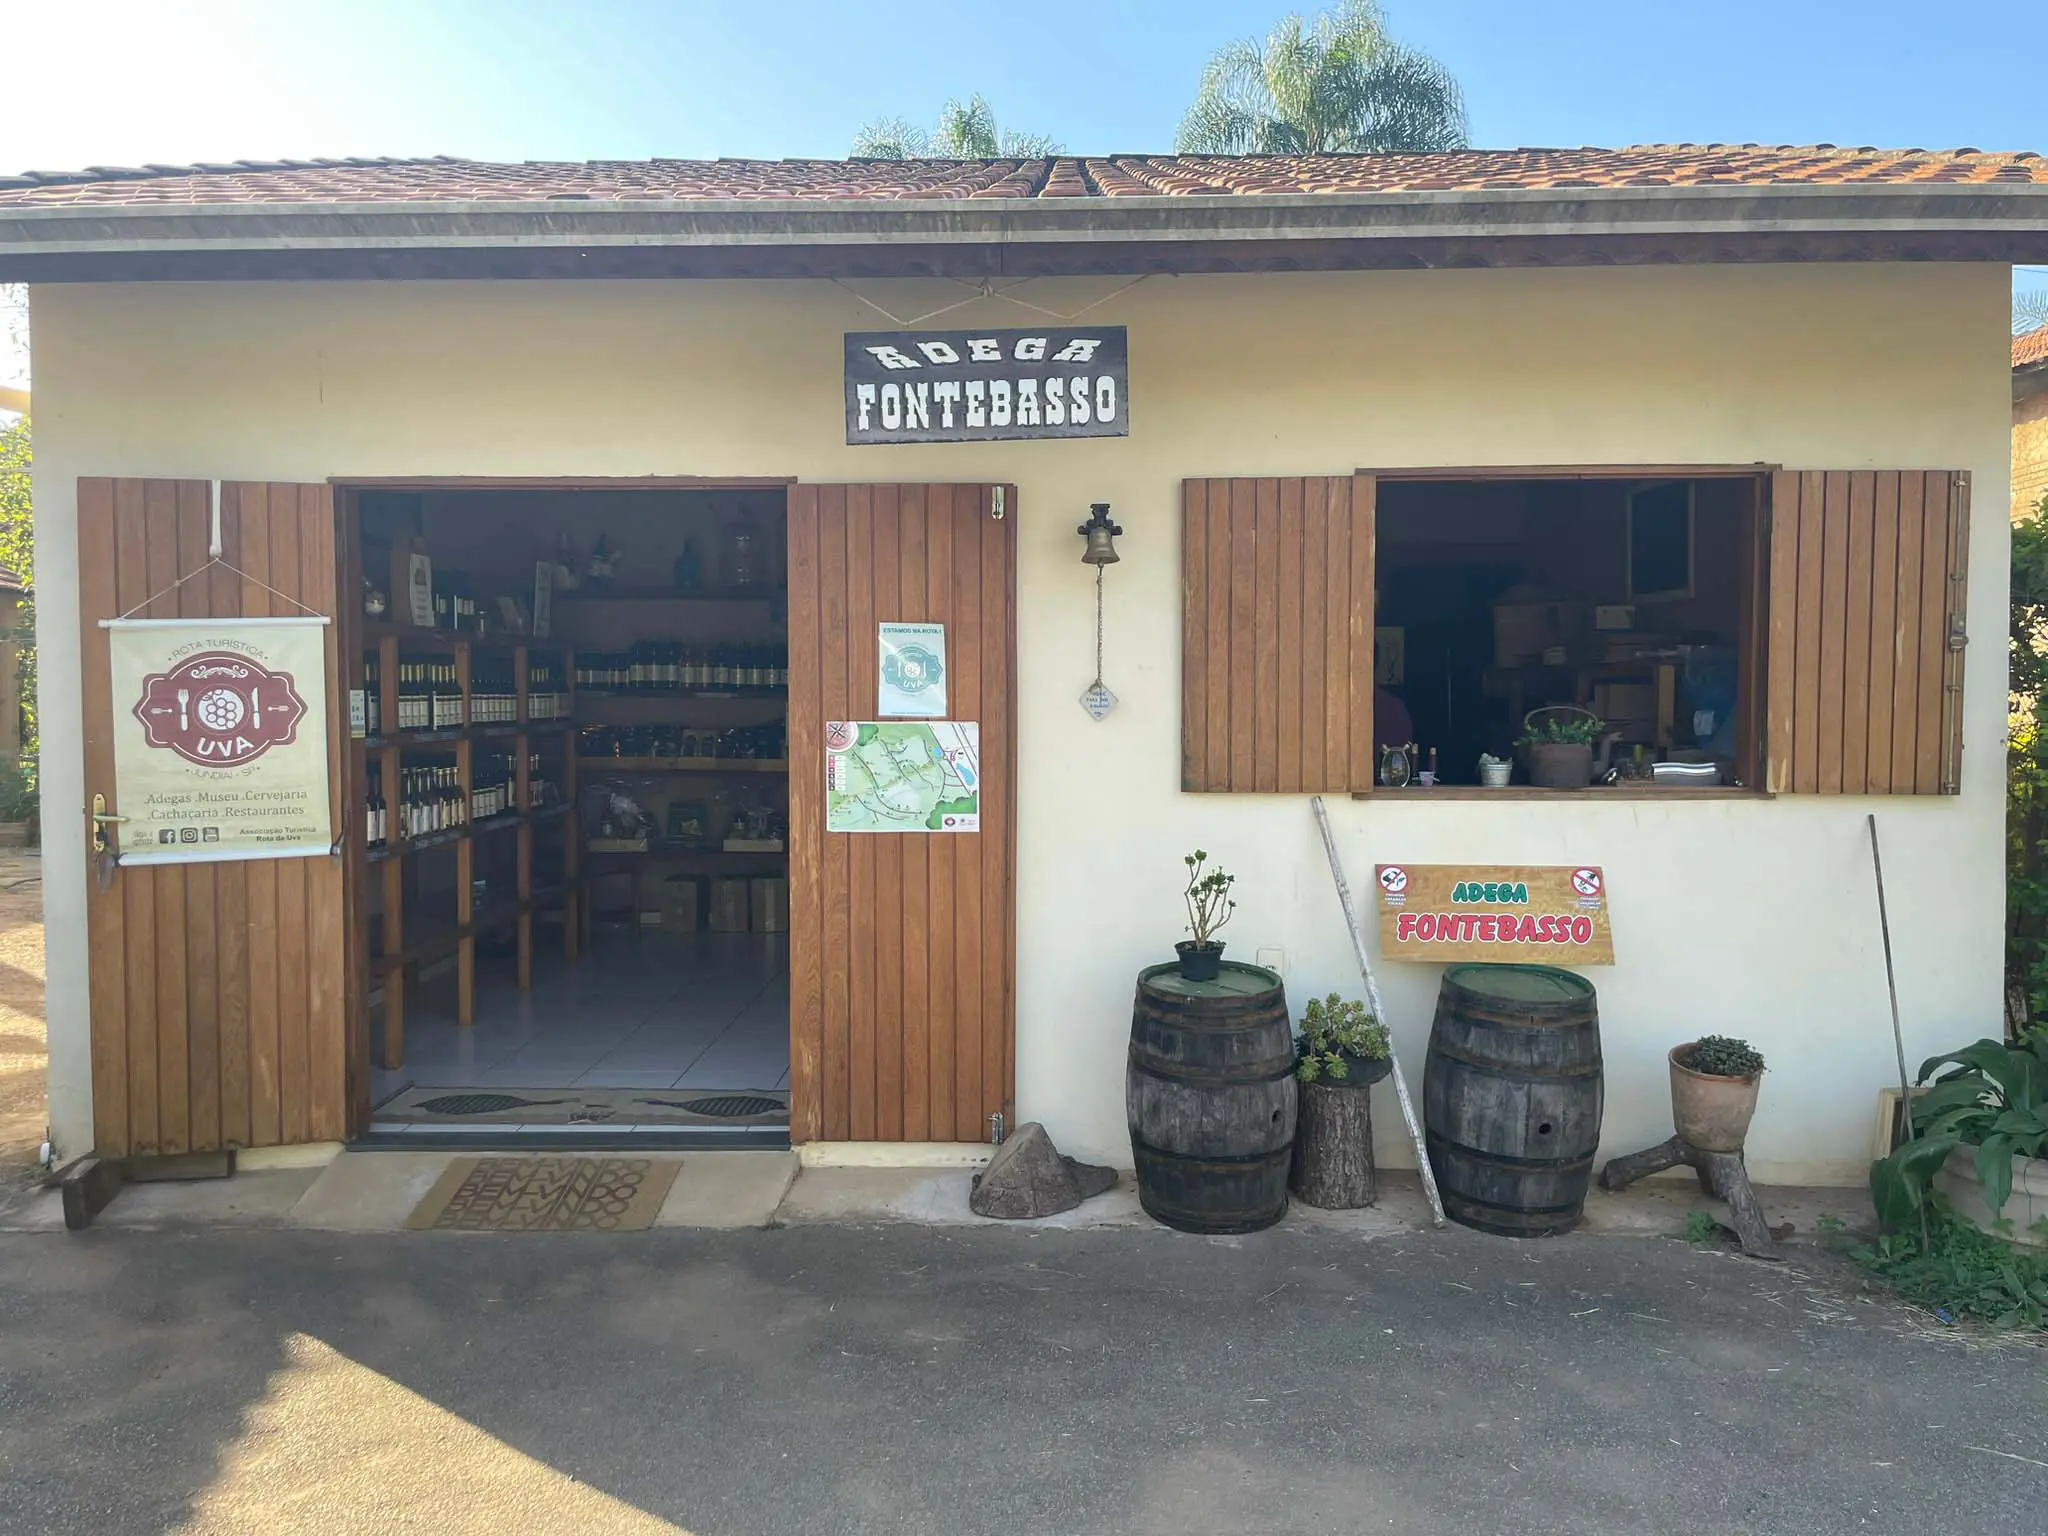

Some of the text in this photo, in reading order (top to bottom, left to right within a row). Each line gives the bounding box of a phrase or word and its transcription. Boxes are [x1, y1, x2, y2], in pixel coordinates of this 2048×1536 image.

[866, 336, 1102, 370] ADEGA
[856, 375, 1116, 431] FONTEBASSO
[172, 639, 264, 659] ROTA TURÍSTICA
[903, 679, 923, 689] UVA
[196, 735, 254, 757] UVA
[1452, 881, 1529, 904] ADEGA
[1397, 913, 1594, 944] FONTEBASSO
[453, 1184, 638, 1200] BEM-VINDO
